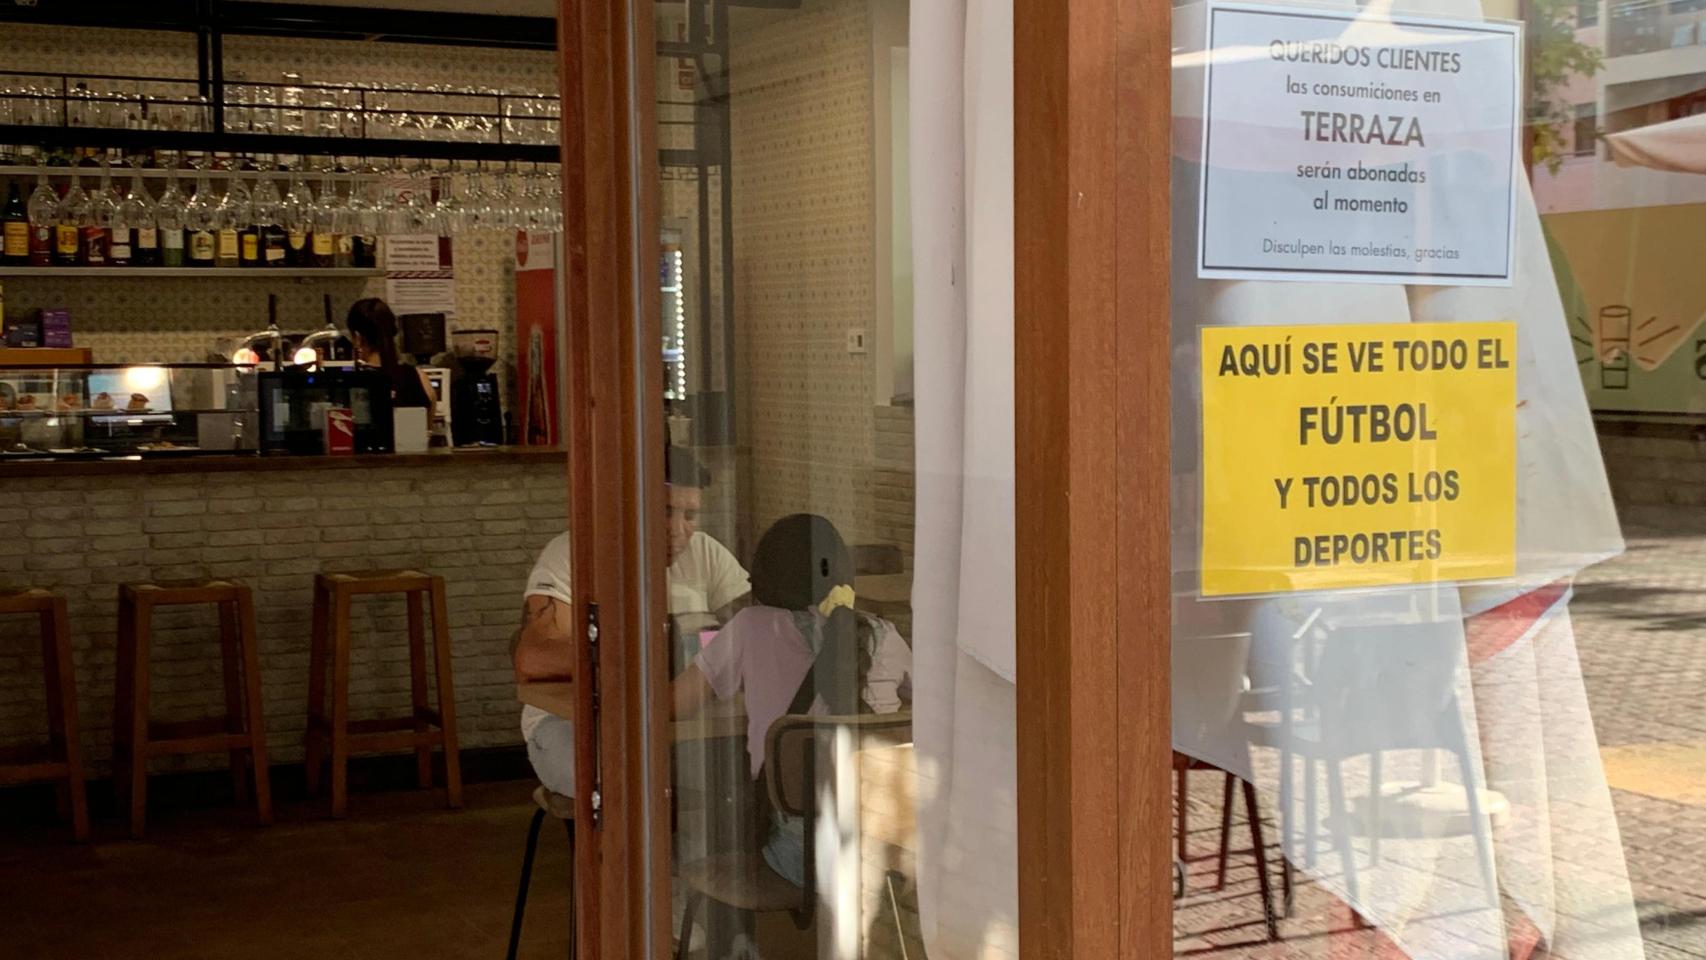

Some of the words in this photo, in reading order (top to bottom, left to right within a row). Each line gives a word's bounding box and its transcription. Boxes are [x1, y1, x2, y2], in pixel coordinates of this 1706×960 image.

[1270, 39, 1371, 67] QUERIDOS
[1377, 48, 1461, 73] CLIENTES
[1286, 75, 1308, 95] las
[1313, 80, 1418, 102] consumiciones
[1423, 90, 1441, 103] en
[1301, 111, 1425, 147] TERRAZA
[1297, 161, 1341, 180] serán
[1347, 161, 1426, 183] abonadas
[1313, 190, 1328, 210] al
[1334, 196, 1408, 213] momento
[1263, 238, 1325, 258] Disculpen
[1329, 240, 1346, 256] las
[1351, 242, 1410, 260] molestias,
[1415, 245, 1460, 262] gracias
[1219, 335, 1292, 378] AQUÍ
[1303, 342, 1338, 374] SE
[1348, 341, 1384, 372] VE
[1393, 339, 1468, 371] TODO
[1477, 338, 1509, 369] EL
[1300, 396, 1437, 445] FÚTBOL
[1274, 478, 1293, 509] Y
[1303, 472, 1398, 508] TODOS
[1408, 470, 1460, 503] LOS
[1294, 529, 1442, 567] DEPORTES
